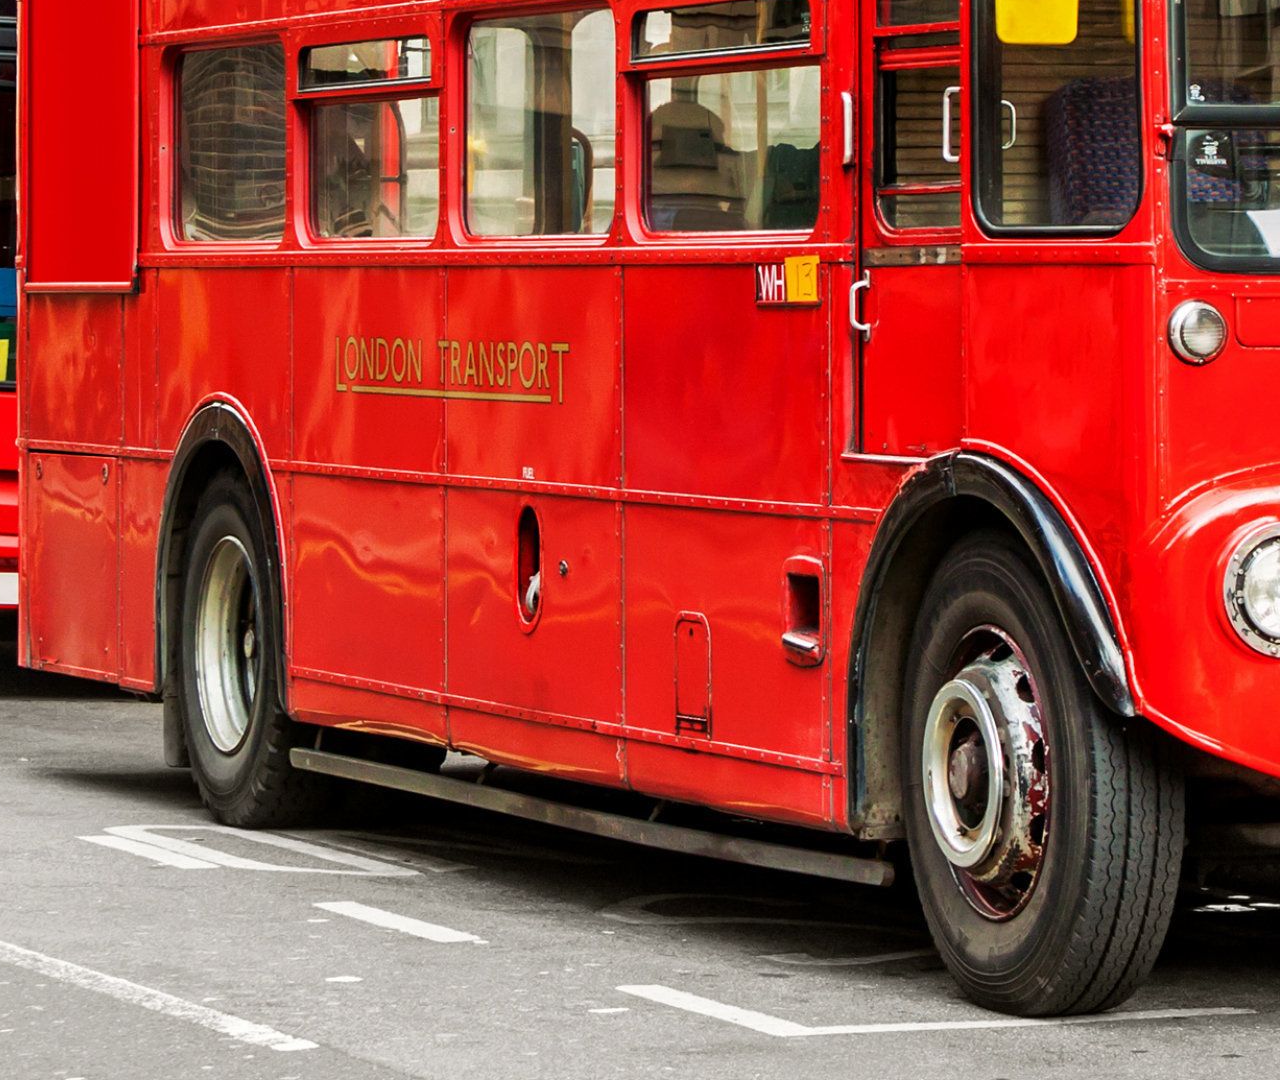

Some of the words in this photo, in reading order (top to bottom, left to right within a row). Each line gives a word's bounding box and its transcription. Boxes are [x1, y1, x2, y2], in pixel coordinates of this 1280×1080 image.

[757, 264, 785, 301] WH
[335, 336, 423, 391] LONDON
[437, 340, 570, 403] TRANSPORT
